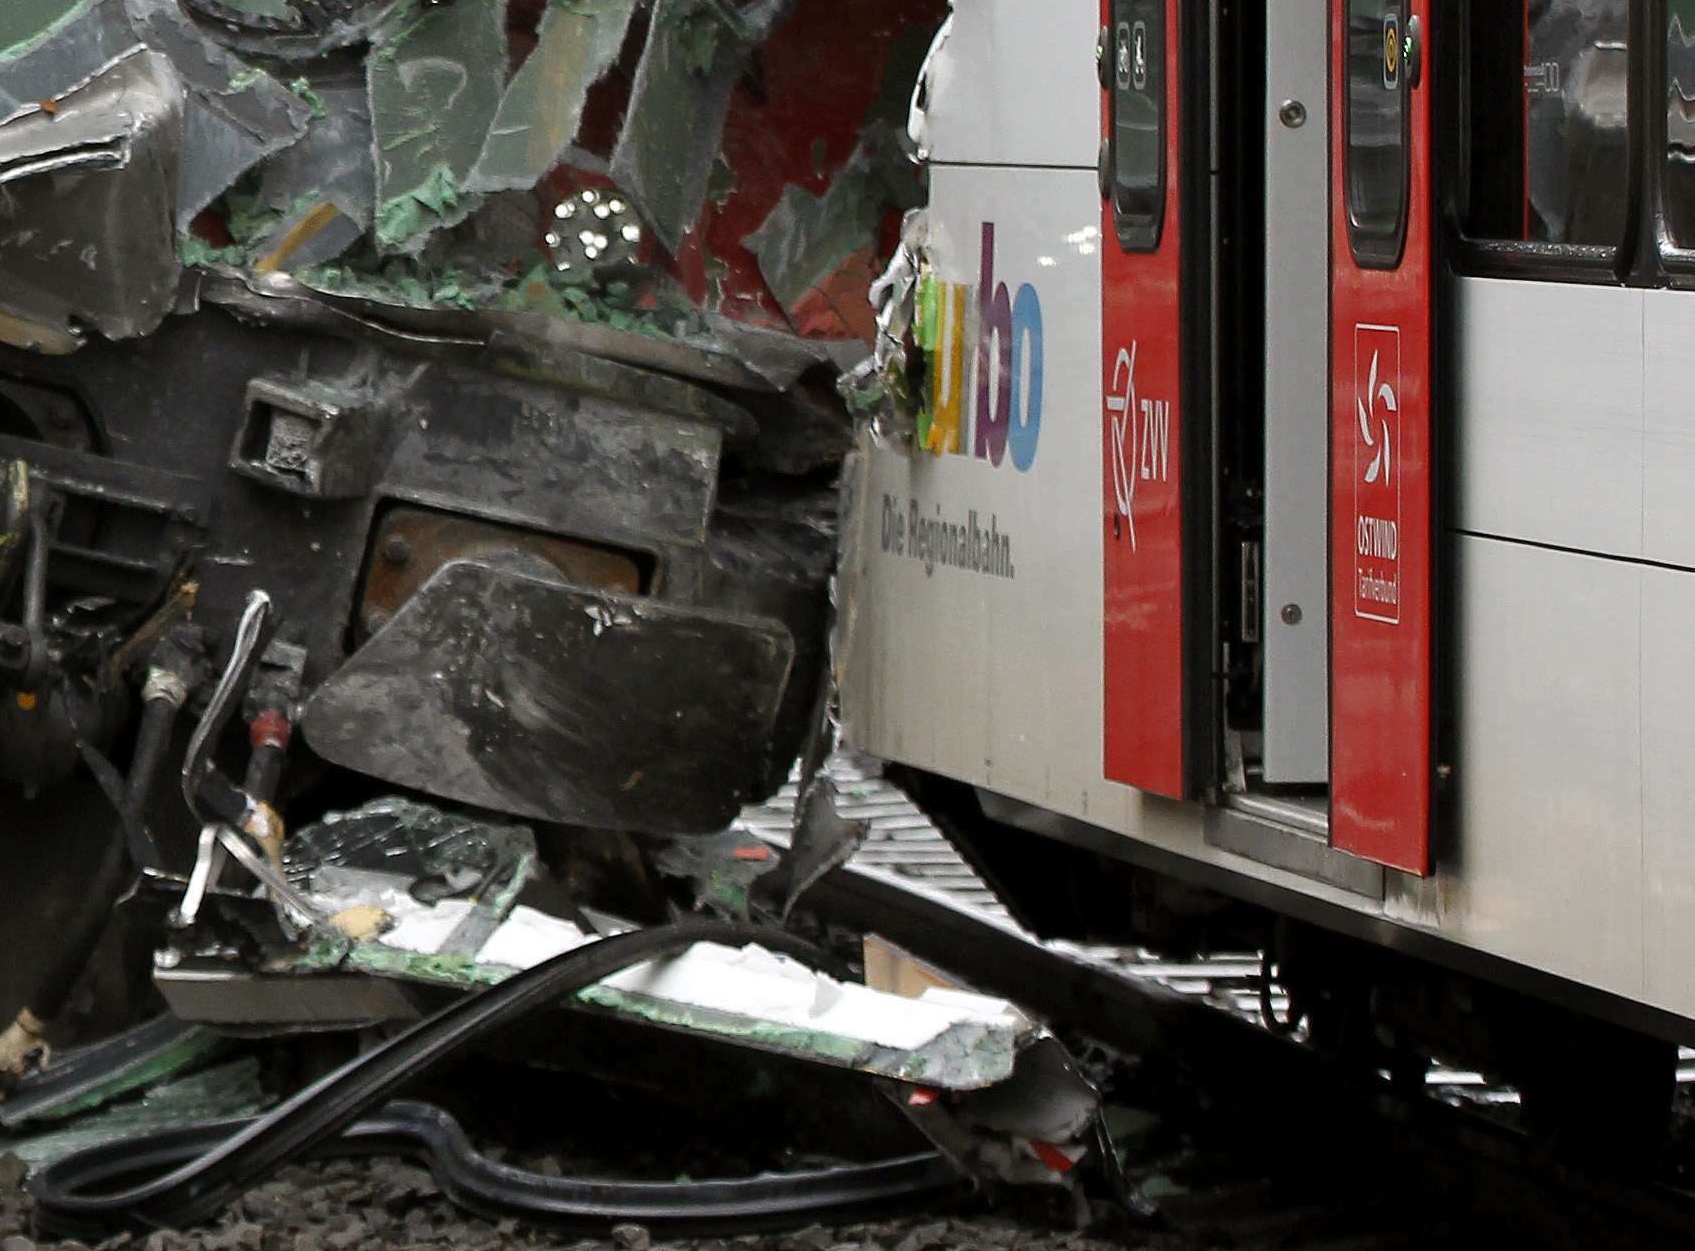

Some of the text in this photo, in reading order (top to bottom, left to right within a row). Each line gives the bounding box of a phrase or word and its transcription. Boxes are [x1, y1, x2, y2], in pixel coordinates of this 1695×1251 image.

[1141, 398, 1170, 482] ZVV
[881, 494, 1015, 579] Die Regionalbahn.
[1357, 515, 1397, 560] OSTWIND
